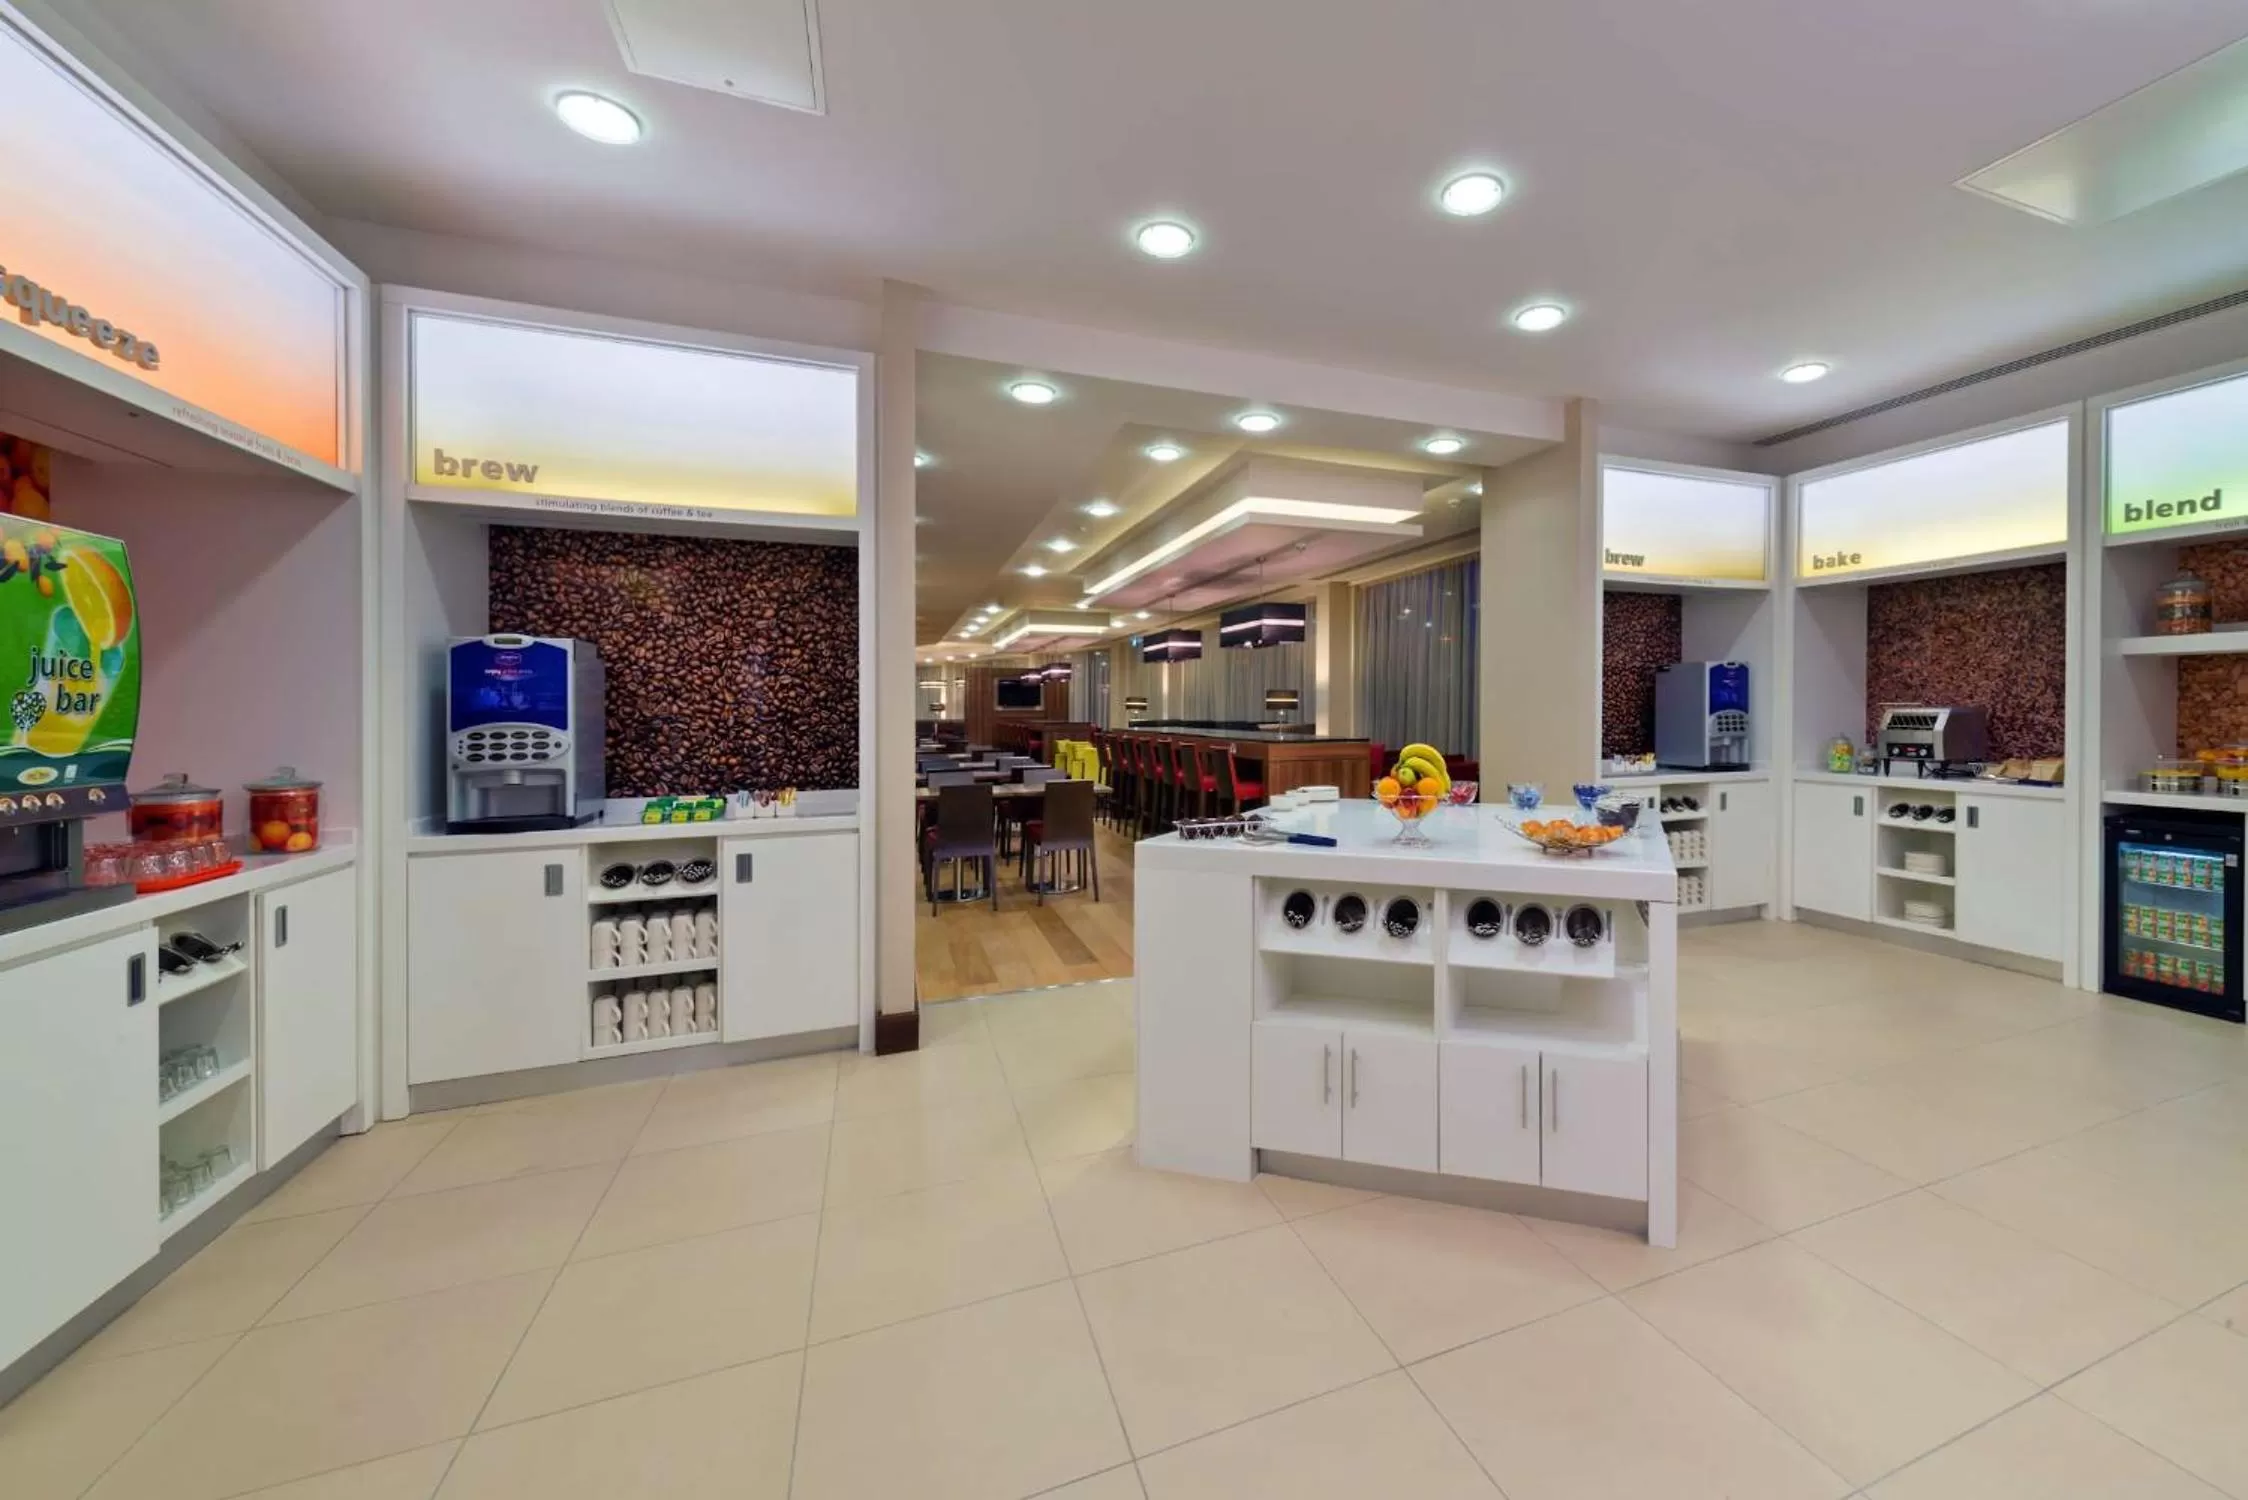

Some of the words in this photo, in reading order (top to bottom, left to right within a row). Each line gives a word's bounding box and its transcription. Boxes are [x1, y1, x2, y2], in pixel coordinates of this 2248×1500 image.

[434, 448, 539, 483] brew
[2124, 488, 2222, 523] blend
[1605, 548, 1645, 567] brew
[1813, 551, 1862, 570] bake
[27, 647, 93, 684] juice
[56, 683, 101, 712] bar
